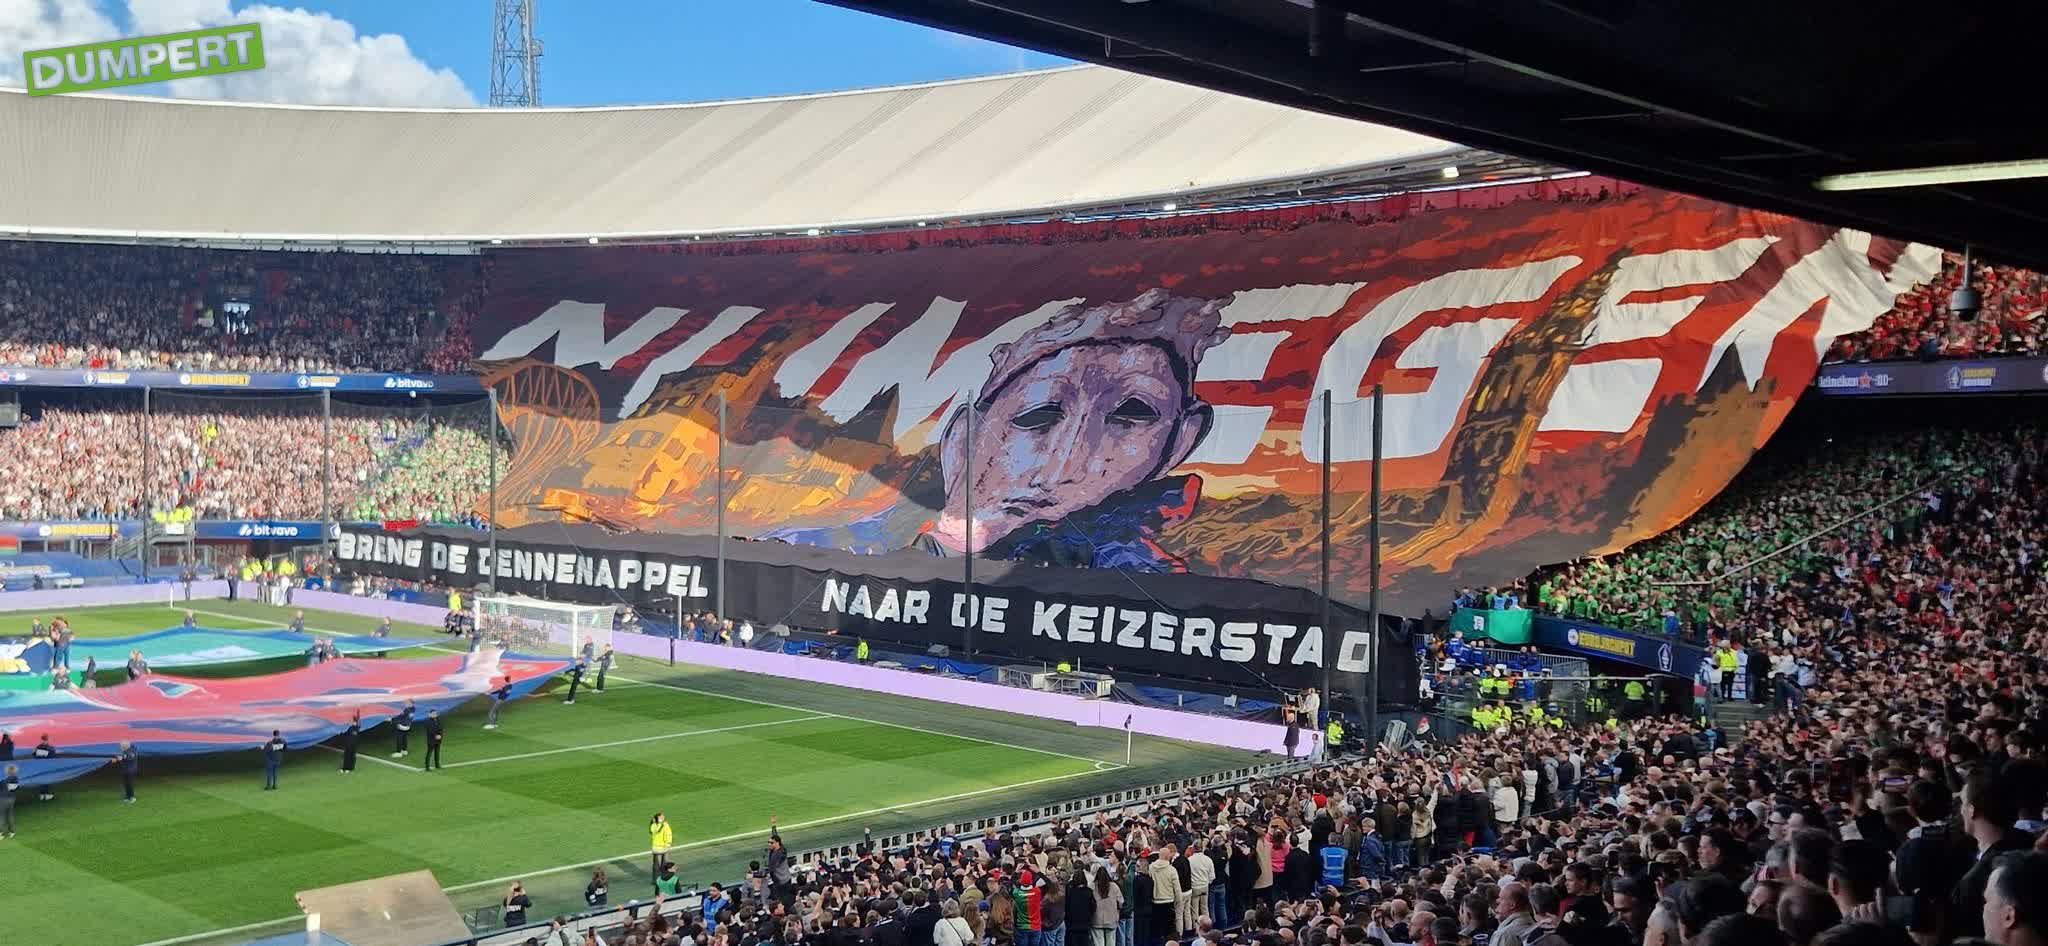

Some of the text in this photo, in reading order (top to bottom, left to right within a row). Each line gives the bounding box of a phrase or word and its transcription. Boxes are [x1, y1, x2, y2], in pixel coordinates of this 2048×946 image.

[253, 524, 299, 537] bitvavo
[338, 532, 424, 568] BRENG
[432, 542, 469, 575] DE
[821, 578, 1370, 673] NAAR DE KEIZERSTAD
